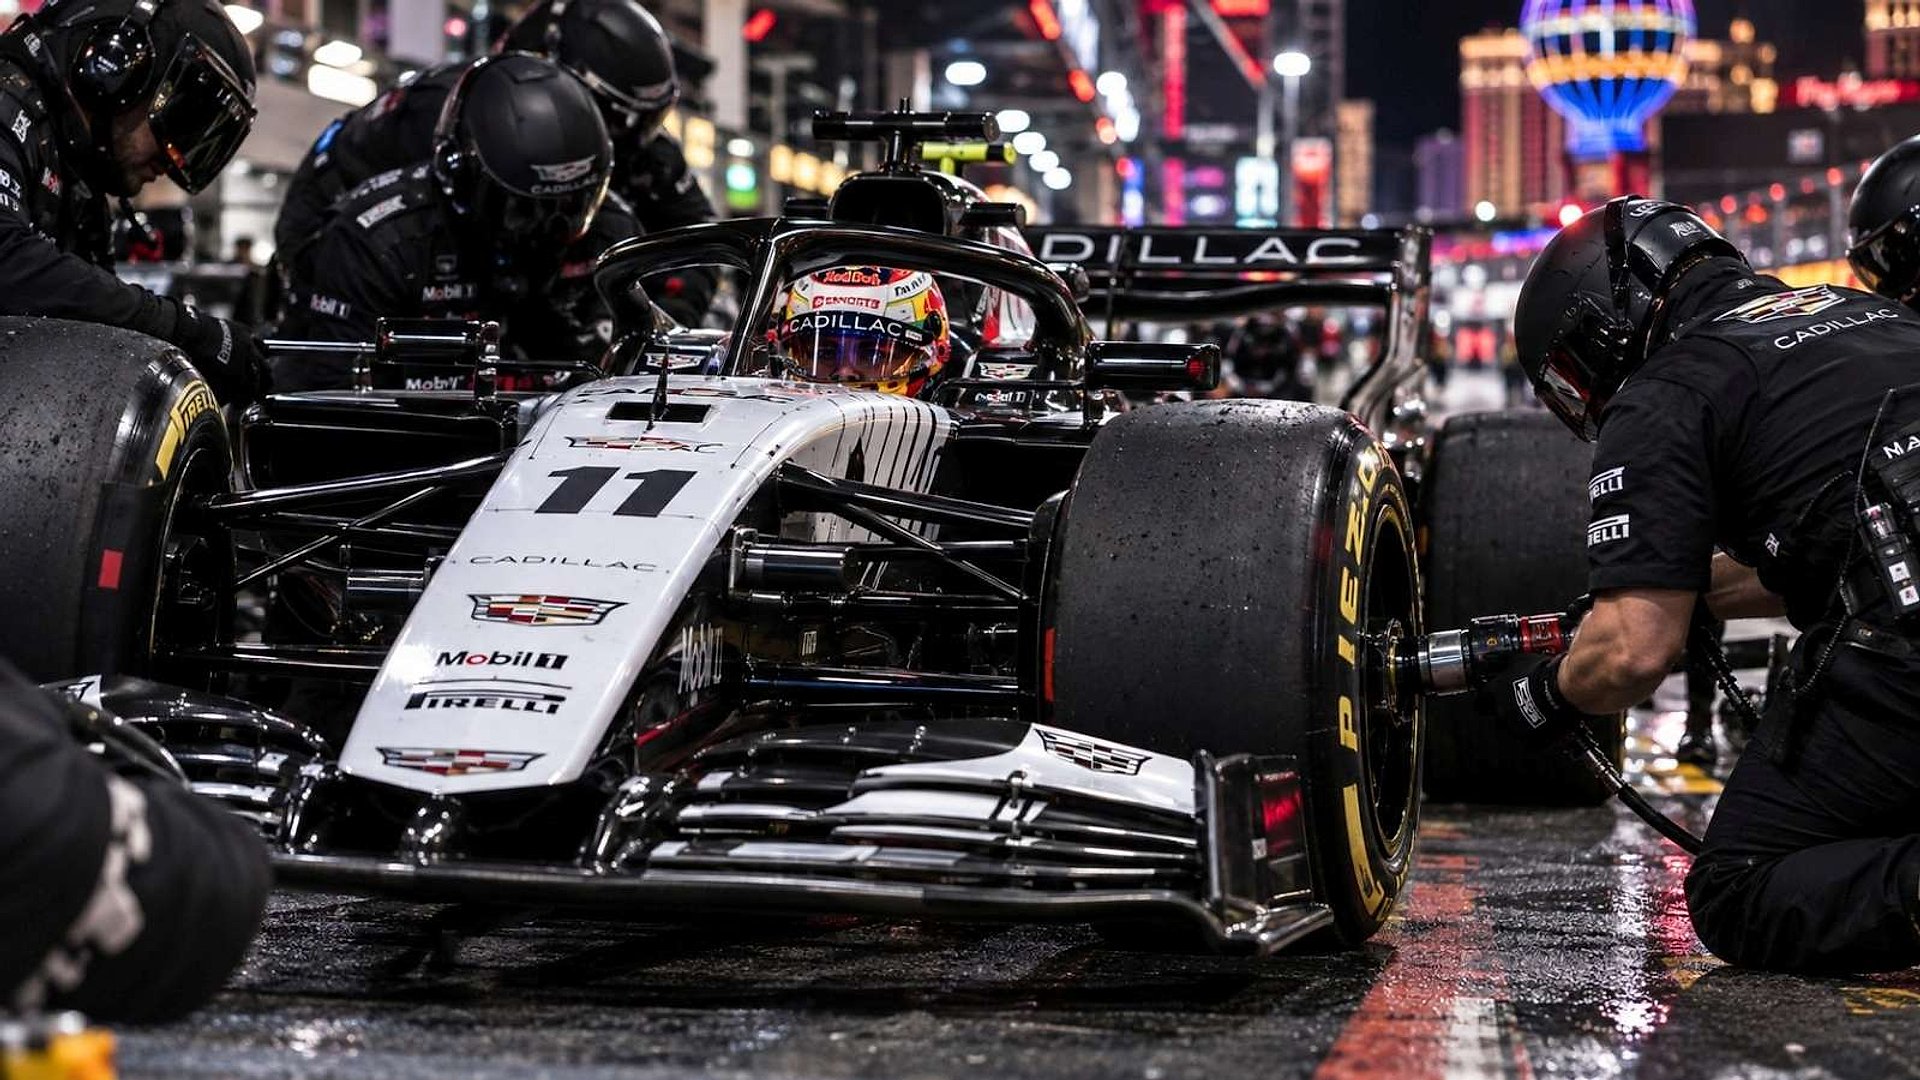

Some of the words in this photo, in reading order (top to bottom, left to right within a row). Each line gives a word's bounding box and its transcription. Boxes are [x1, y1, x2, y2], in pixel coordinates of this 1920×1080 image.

[1040, 234, 1364, 264] DILLAC
[790, 315, 902, 336] CADILLAC
[1774, 309, 1898, 350] CADILLAC
[534, 466, 698, 518] 11
[470, 556, 658, 573] CADILLAC
[435, 651, 532, 667] Mobil
[404, 689, 567, 715] PIRELLI
